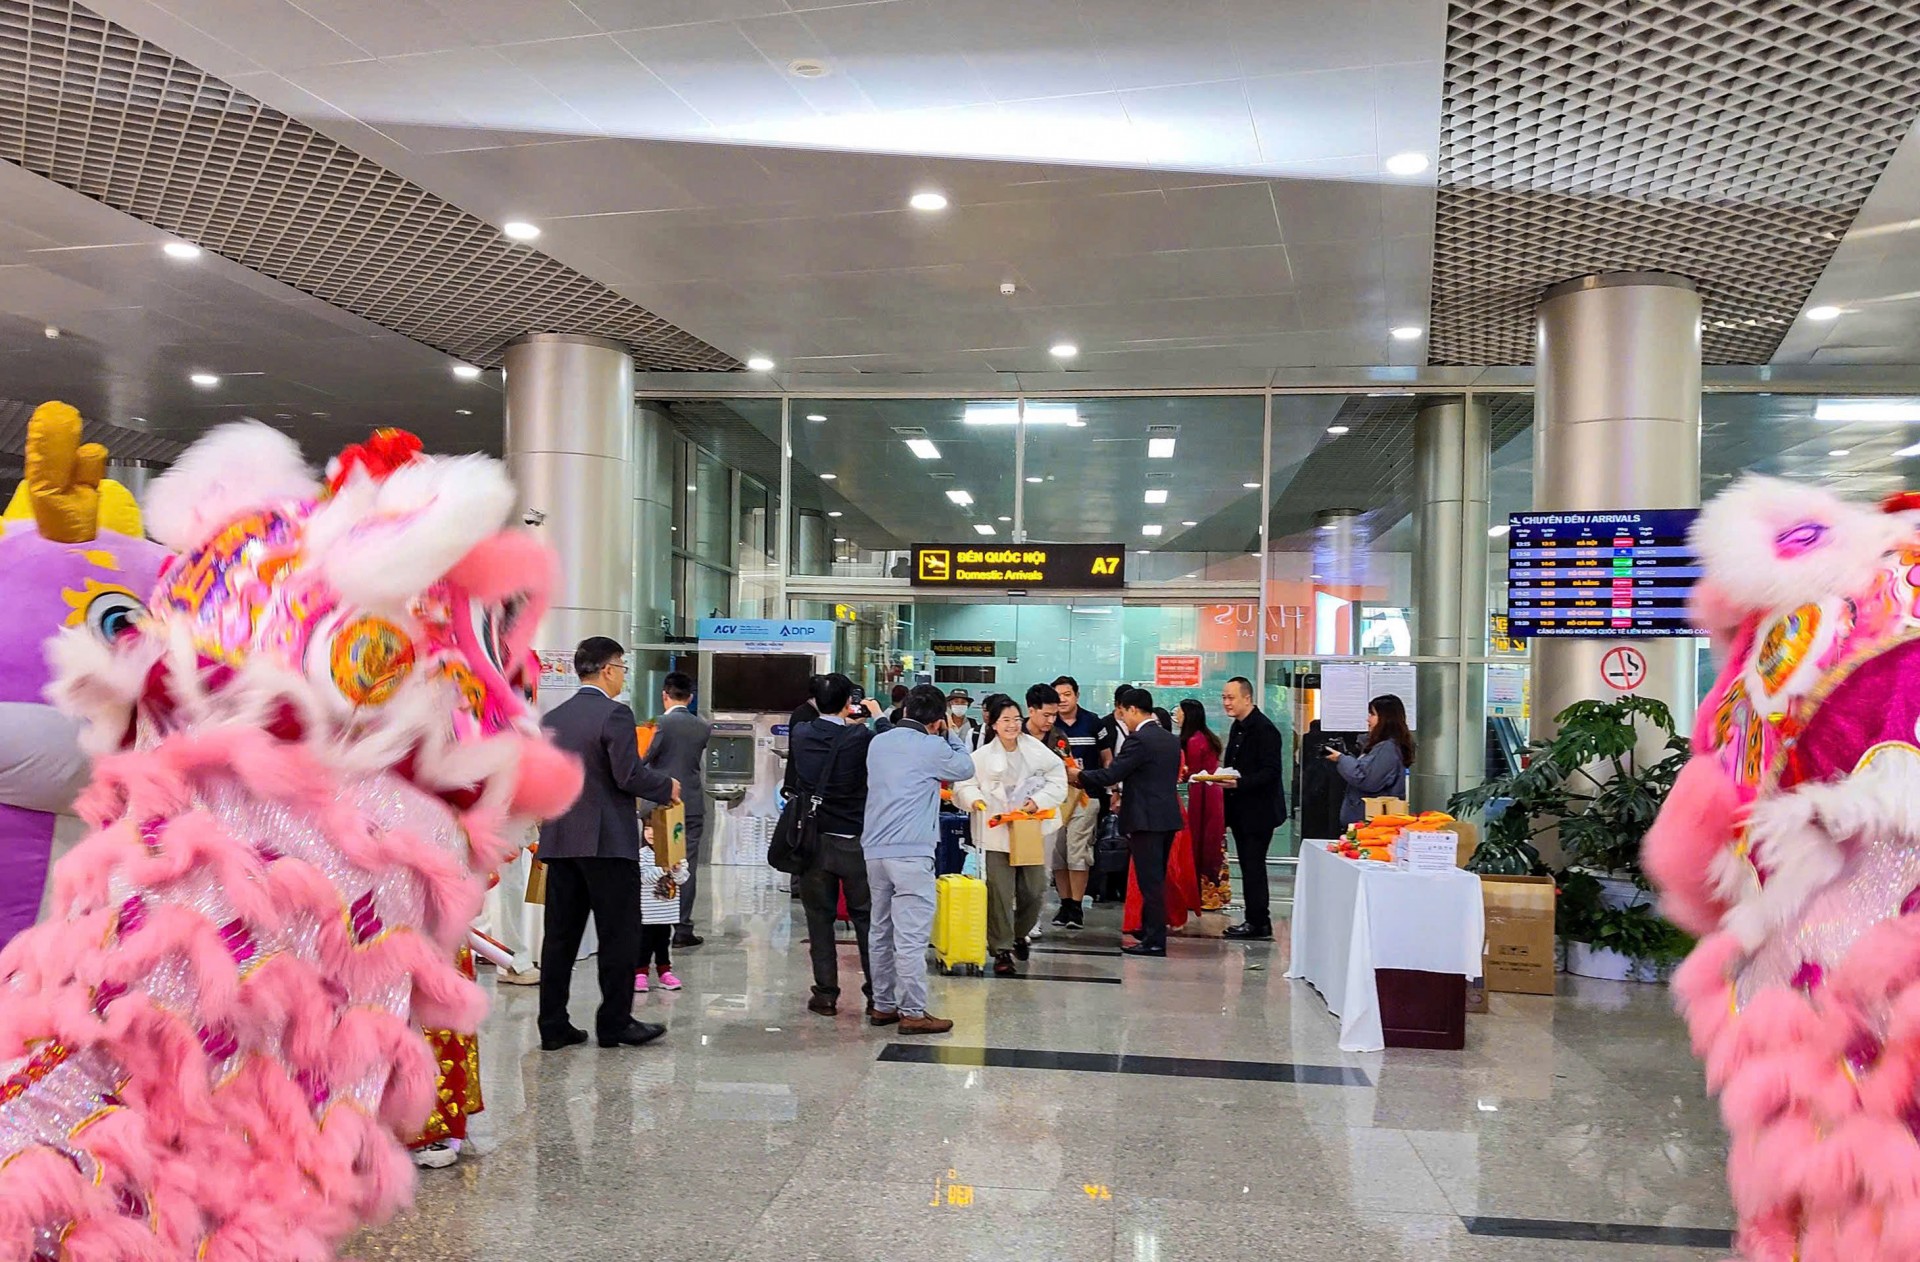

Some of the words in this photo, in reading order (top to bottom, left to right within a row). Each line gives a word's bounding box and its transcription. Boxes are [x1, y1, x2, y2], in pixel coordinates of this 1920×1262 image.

[1592, 514, 1640, 524] ARRIVALS
[985, 550, 1020, 564] QUỐC
[1023, 550, 1046, 566] NỘI
[1091, 557, 1120, 575] A7
[956, 570, 1003, 580] Domestic
[1004, 570, 1044, 581] Arrivals
[714, 625, 737, 633] ACV
